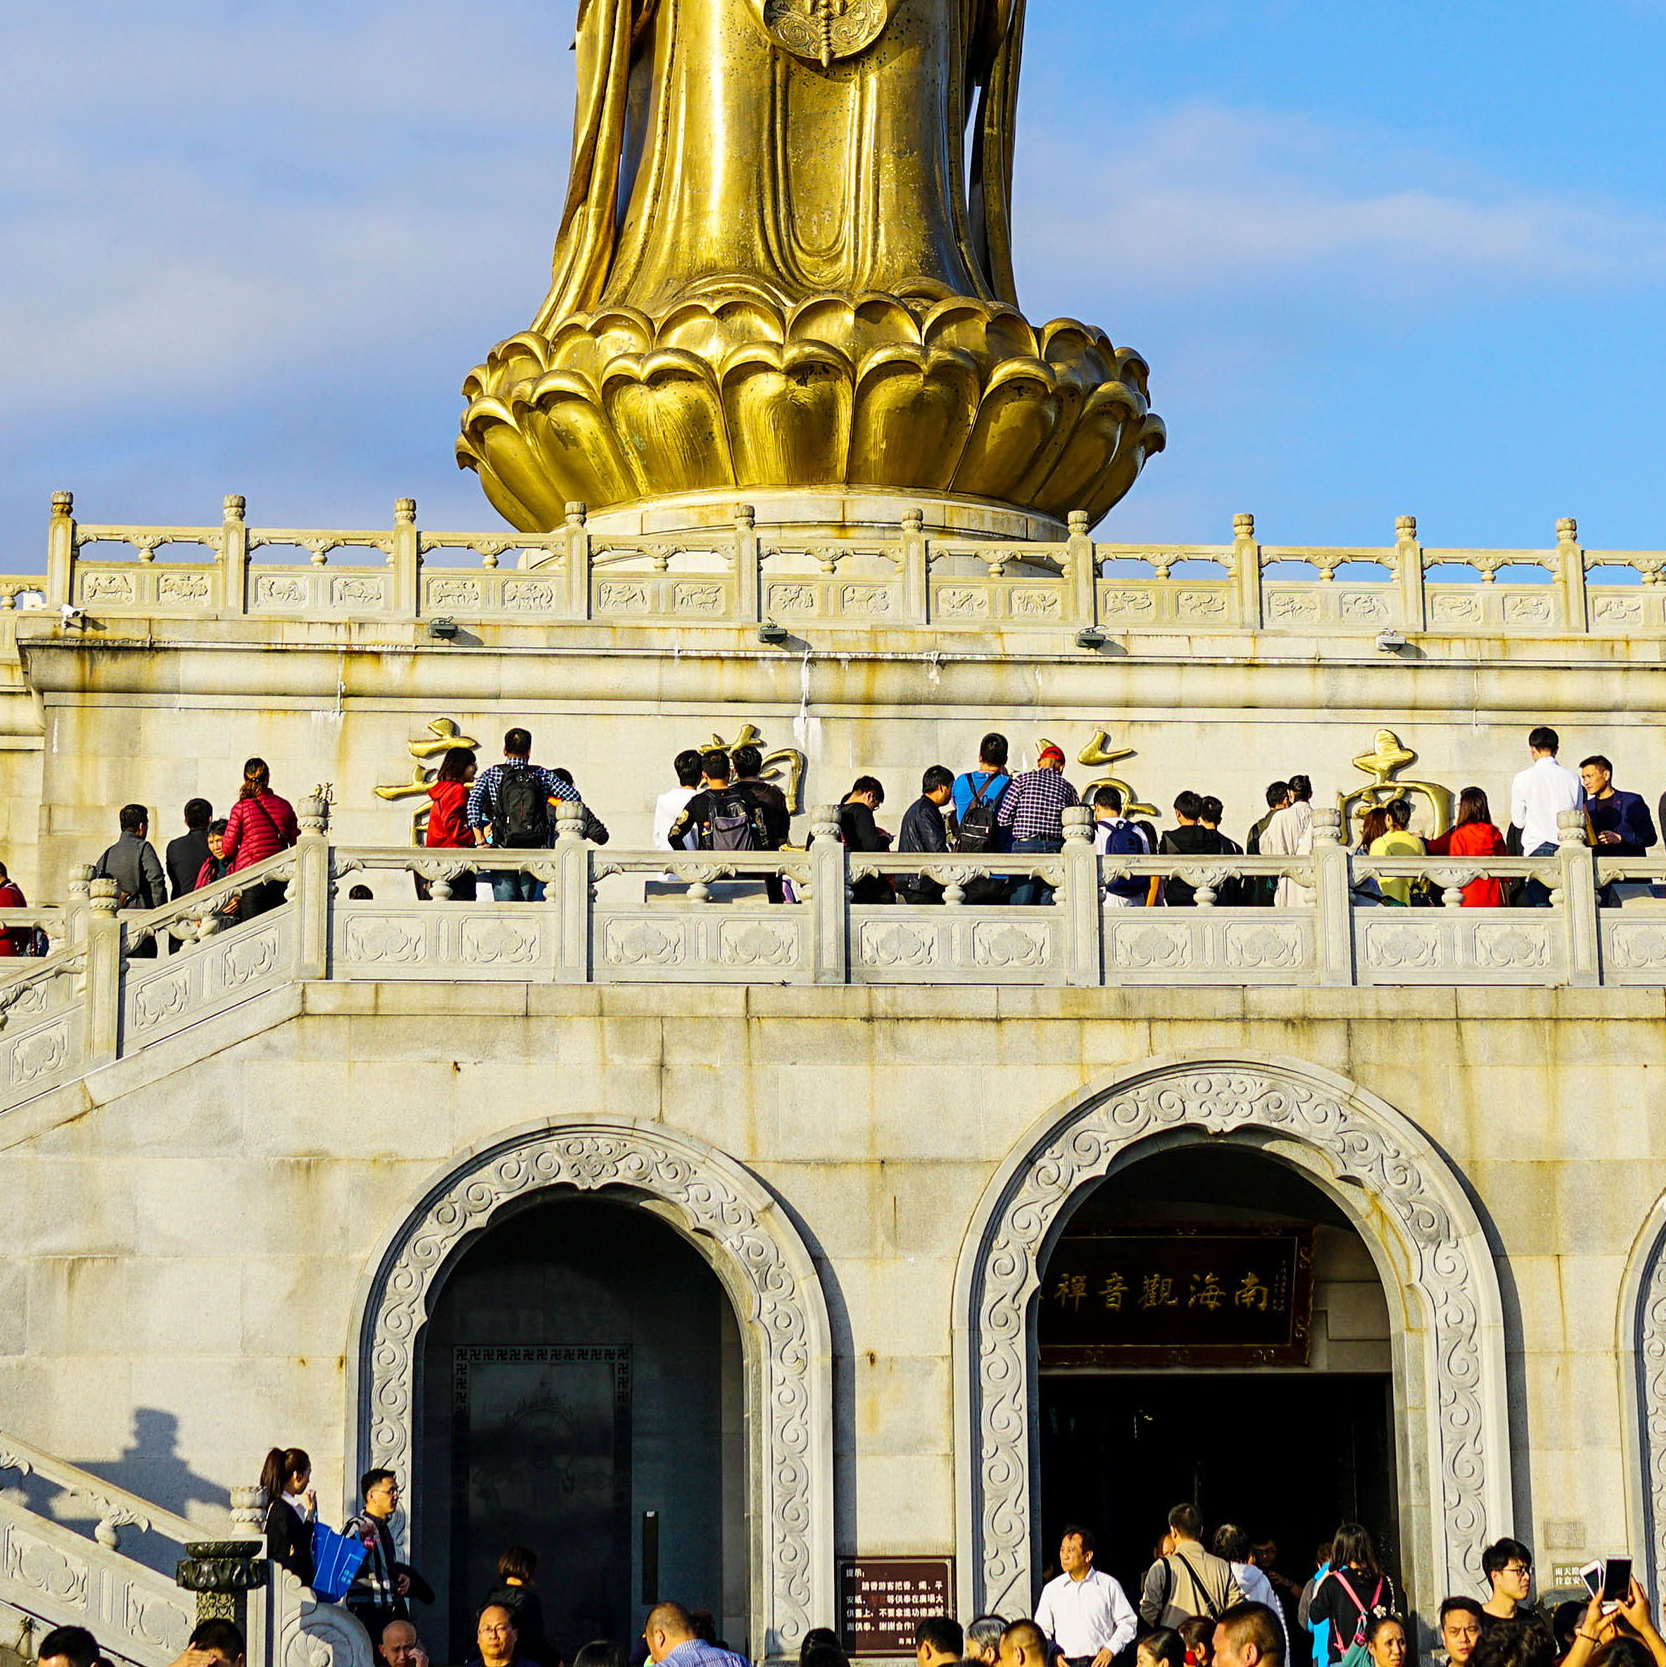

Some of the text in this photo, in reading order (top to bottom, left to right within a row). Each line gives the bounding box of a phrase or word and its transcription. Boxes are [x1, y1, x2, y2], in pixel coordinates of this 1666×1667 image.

[1052, 1270, 1269, 1312] 南海觀音禪
